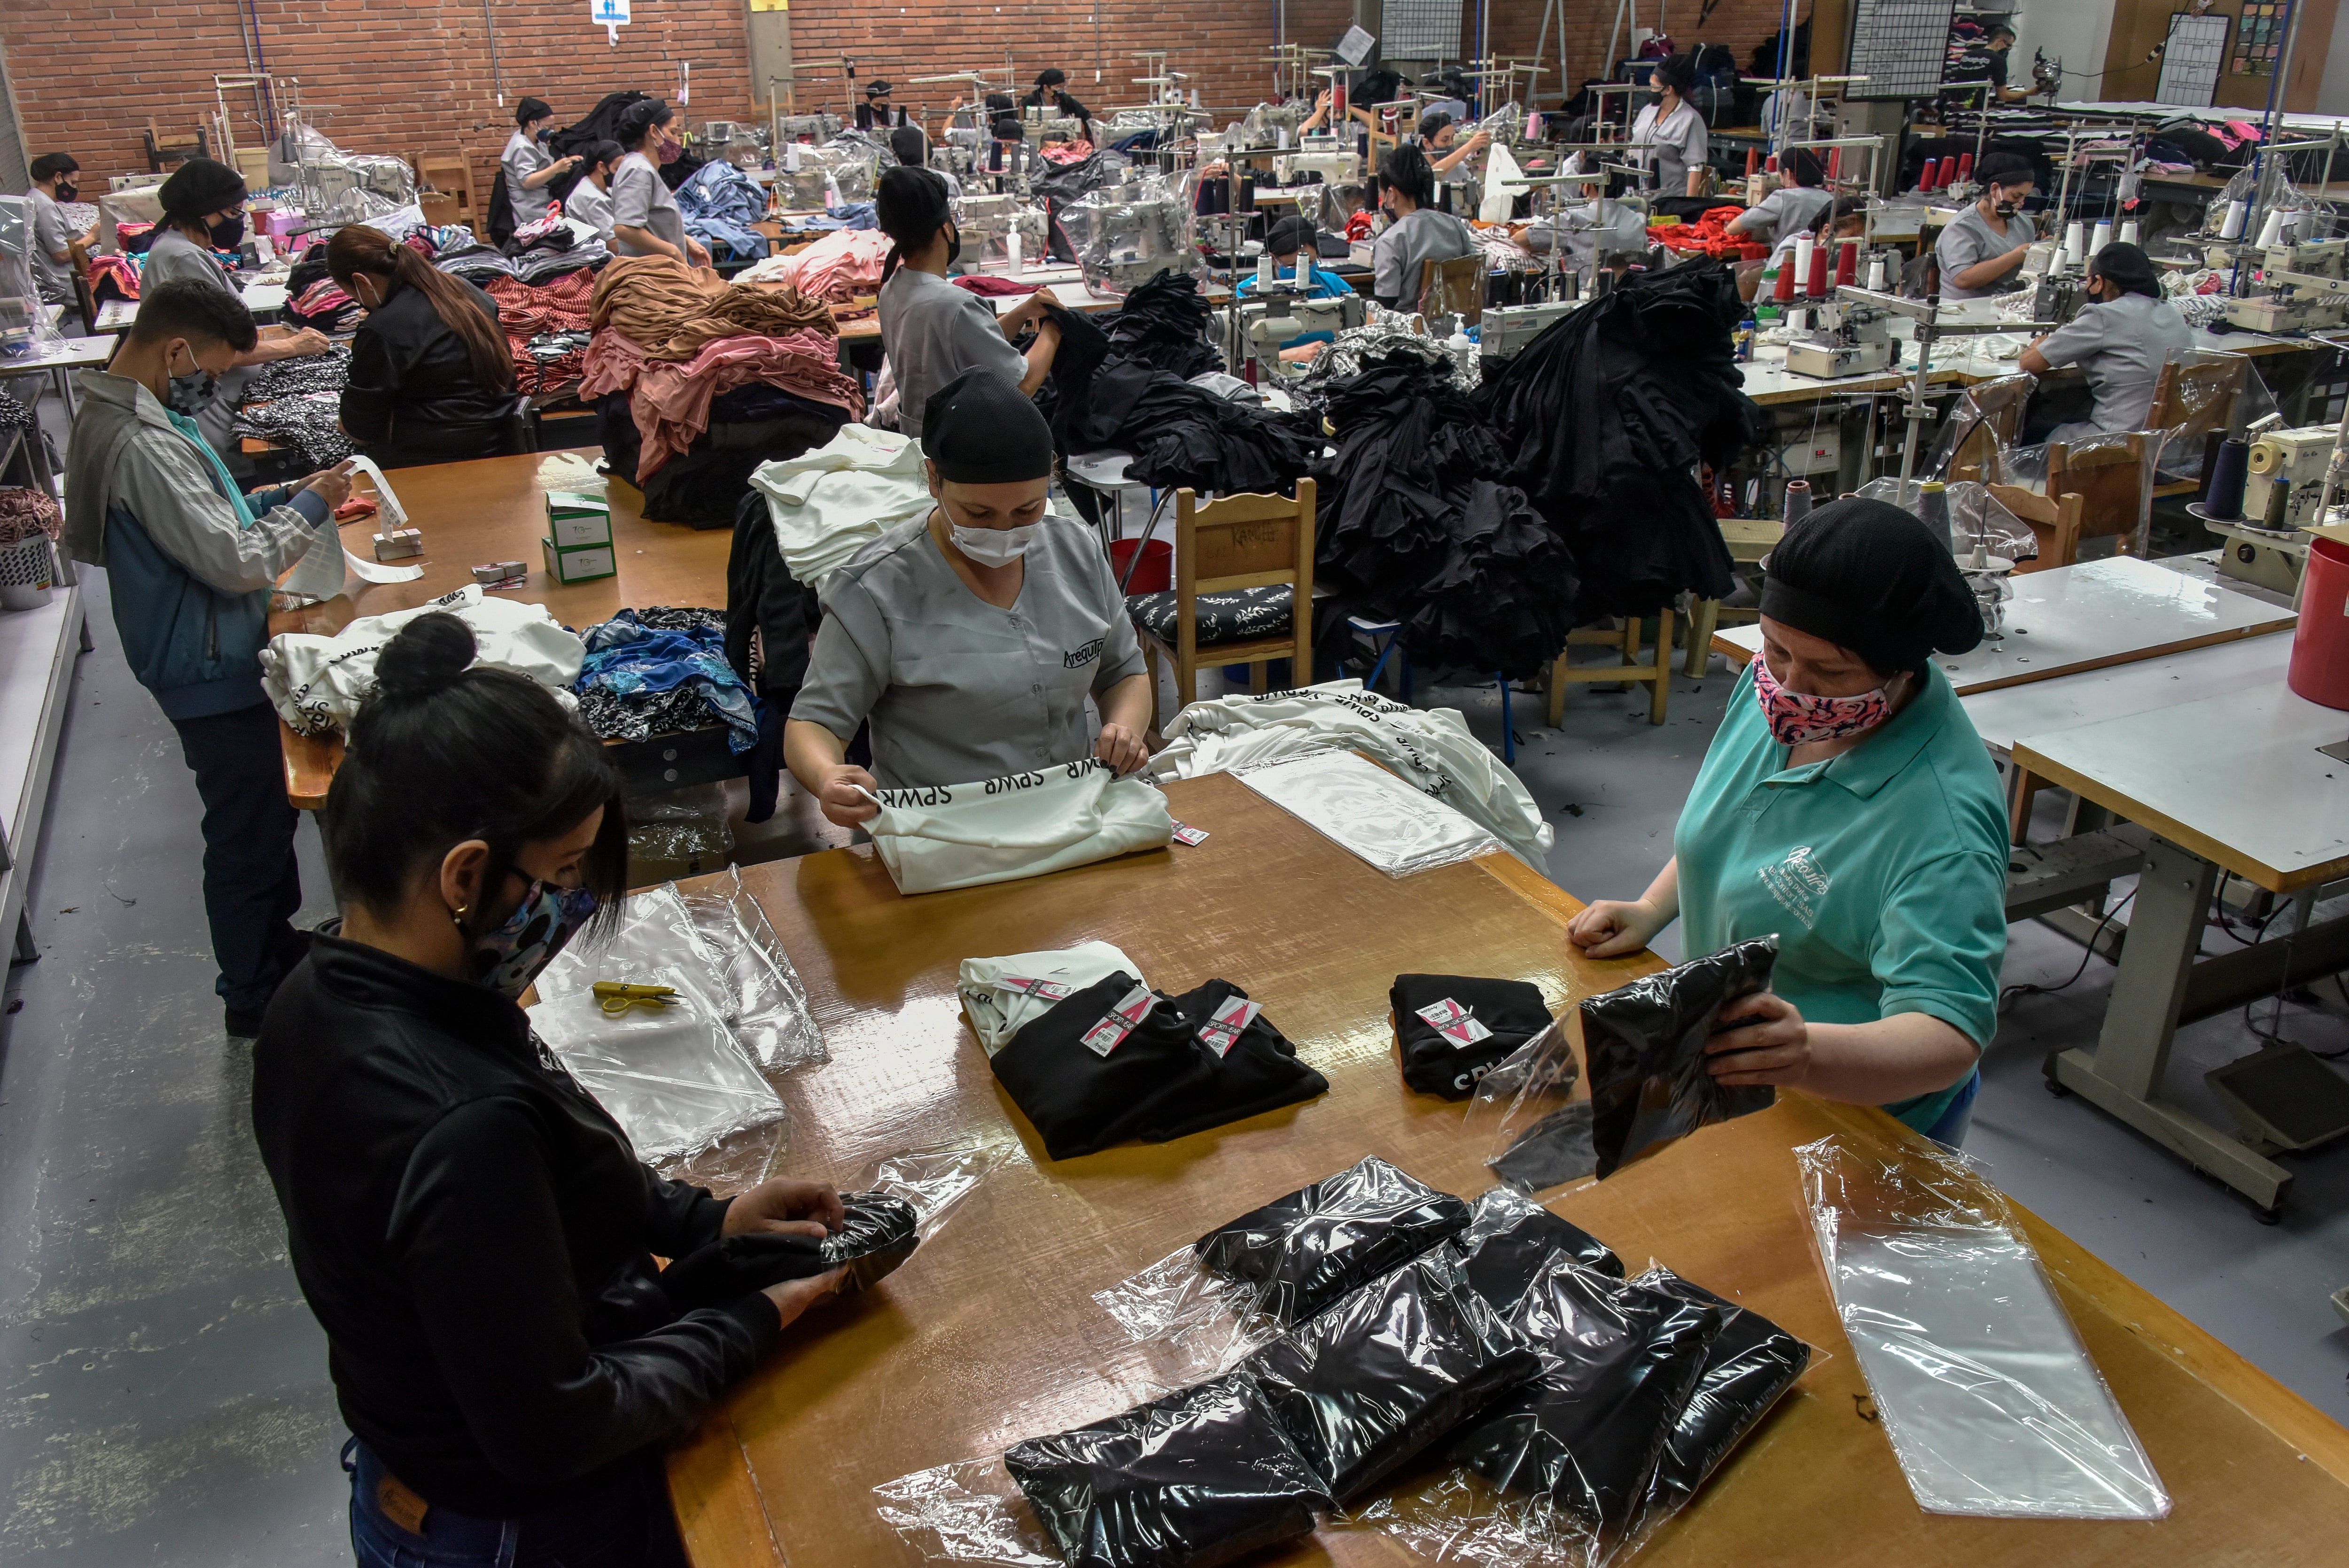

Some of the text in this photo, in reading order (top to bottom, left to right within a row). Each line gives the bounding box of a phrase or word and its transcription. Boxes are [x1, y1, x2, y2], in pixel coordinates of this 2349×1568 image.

[1064, 639, 1103, 668] Arequip
[879, 785, 952, 808] SPWR
[985, 771, 1044, 795] SPWR
[1766, 865, 1813, 917] AB Confort SAS
[1779, 867, 1793, 885] Moda
[1758, 867, 1813, 930] www.arequipe.com.co
